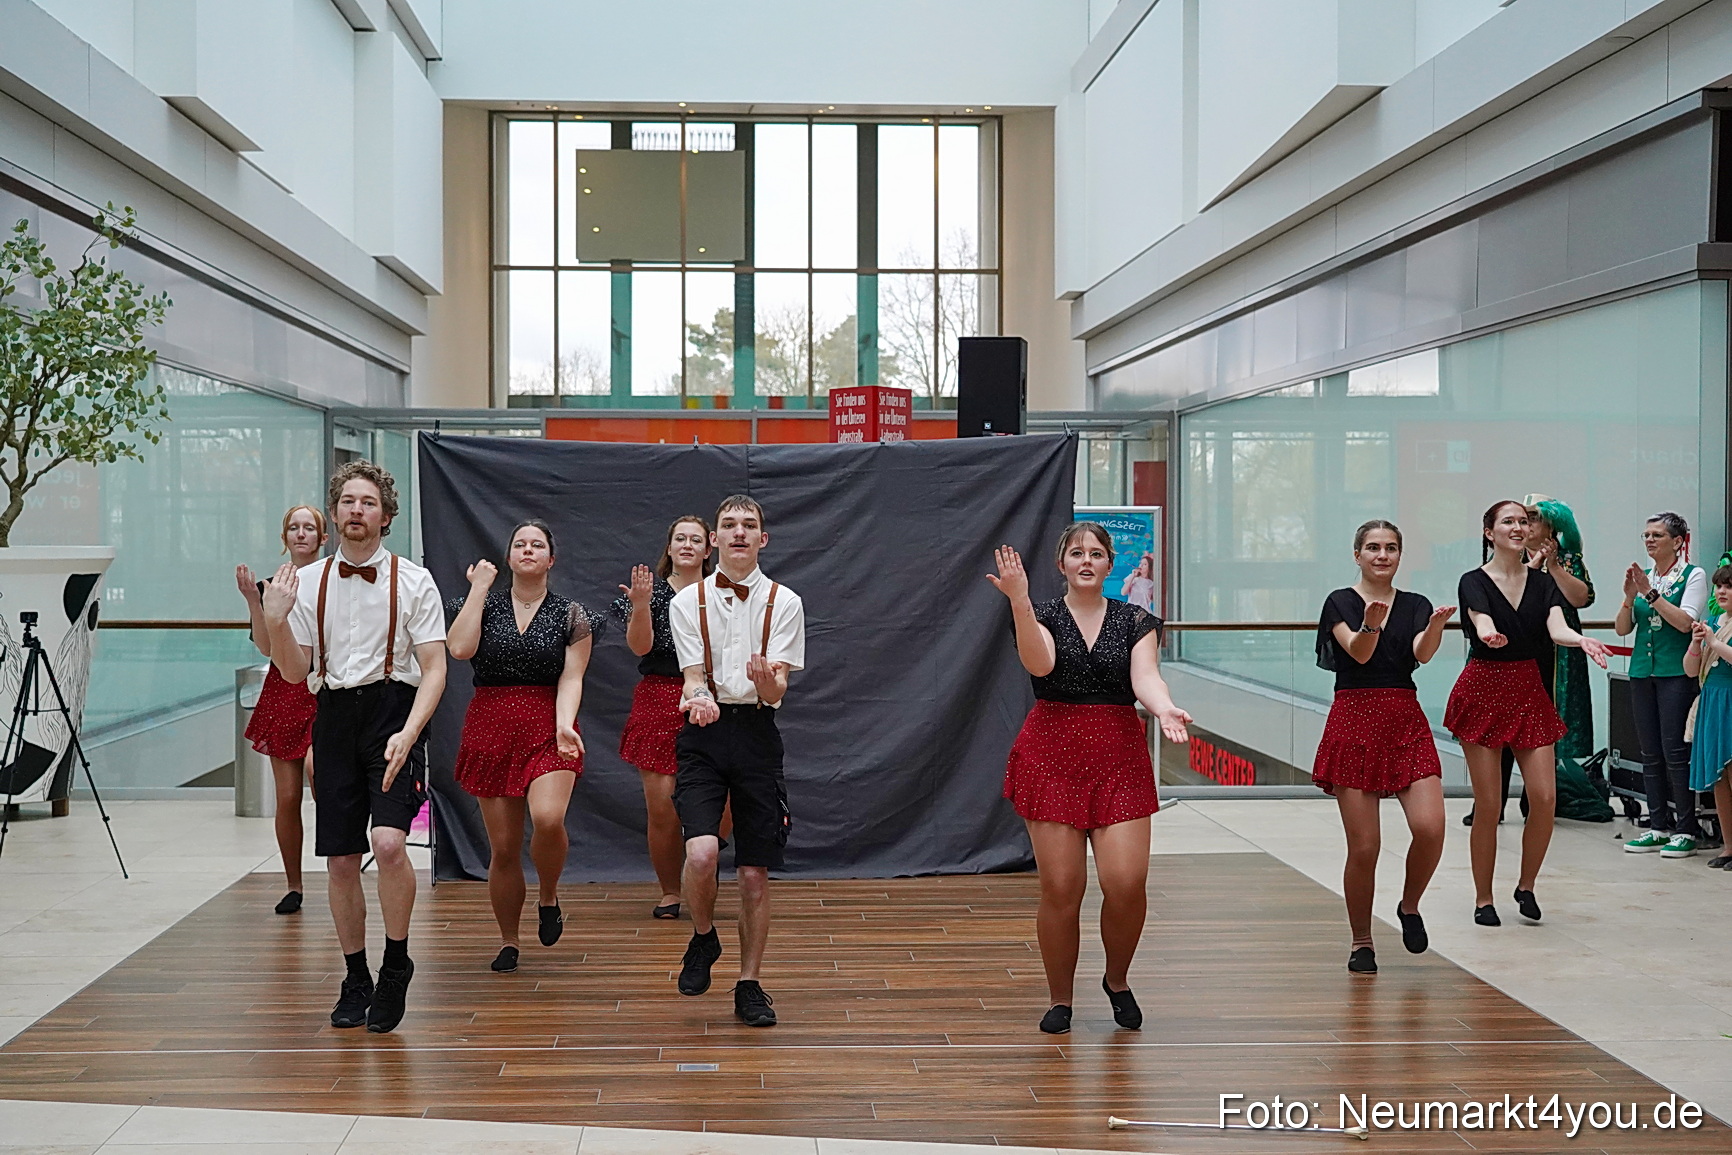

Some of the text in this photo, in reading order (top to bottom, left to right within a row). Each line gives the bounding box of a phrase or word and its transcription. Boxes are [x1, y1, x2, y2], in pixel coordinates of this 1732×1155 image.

[843, 393, 857, 406] finden
[858, 395, 866, 405] uns
[886, 392, 898, 406] finden
[836, 412, 840, 425] in
[849, 409, 865, 425] Unteren
[879, 411, 883, 424] in
[891, 409, 906, 425] Unteren
[1189, 735, 1214, 780] REWE
